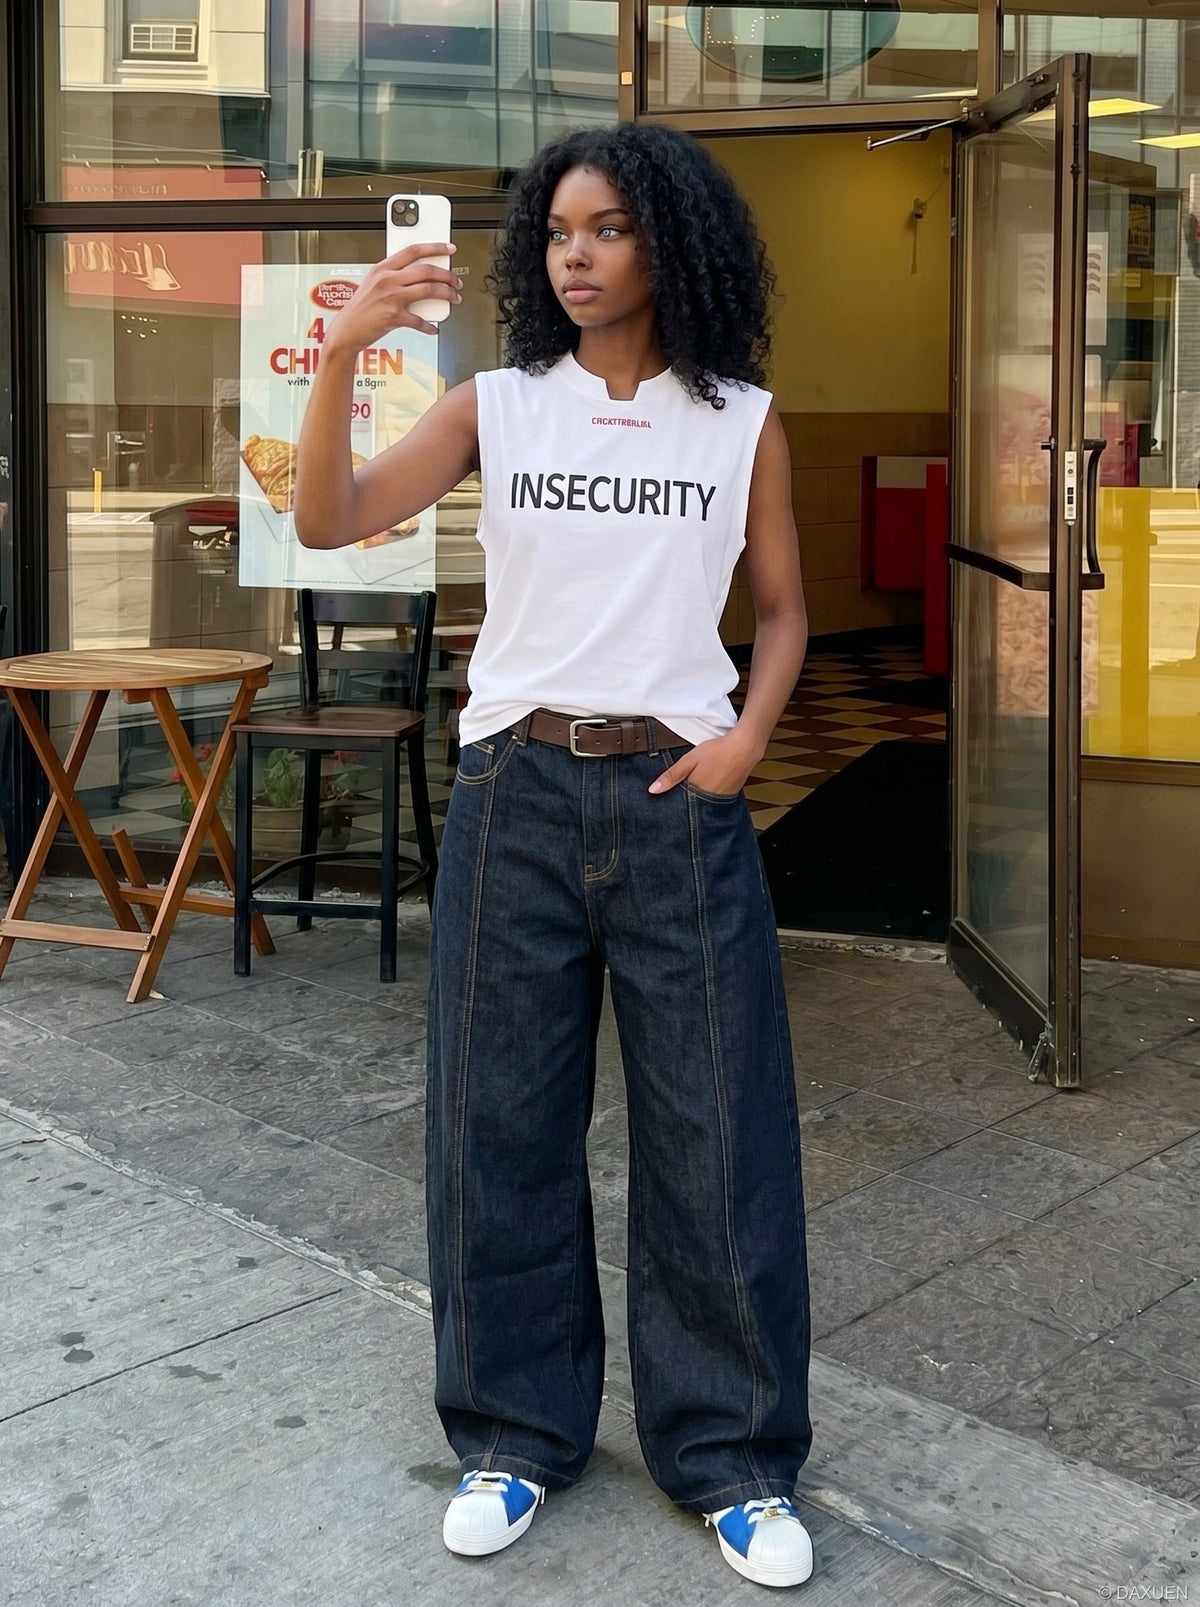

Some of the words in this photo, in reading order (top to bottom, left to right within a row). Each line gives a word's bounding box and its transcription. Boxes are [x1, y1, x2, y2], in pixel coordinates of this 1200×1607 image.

[307, 317, 326, 344] 4
[269, 347, 403, 375] CHIEN
[287, 377, 310, 386] with
[511, 472, 717, 521] INSECURITY
